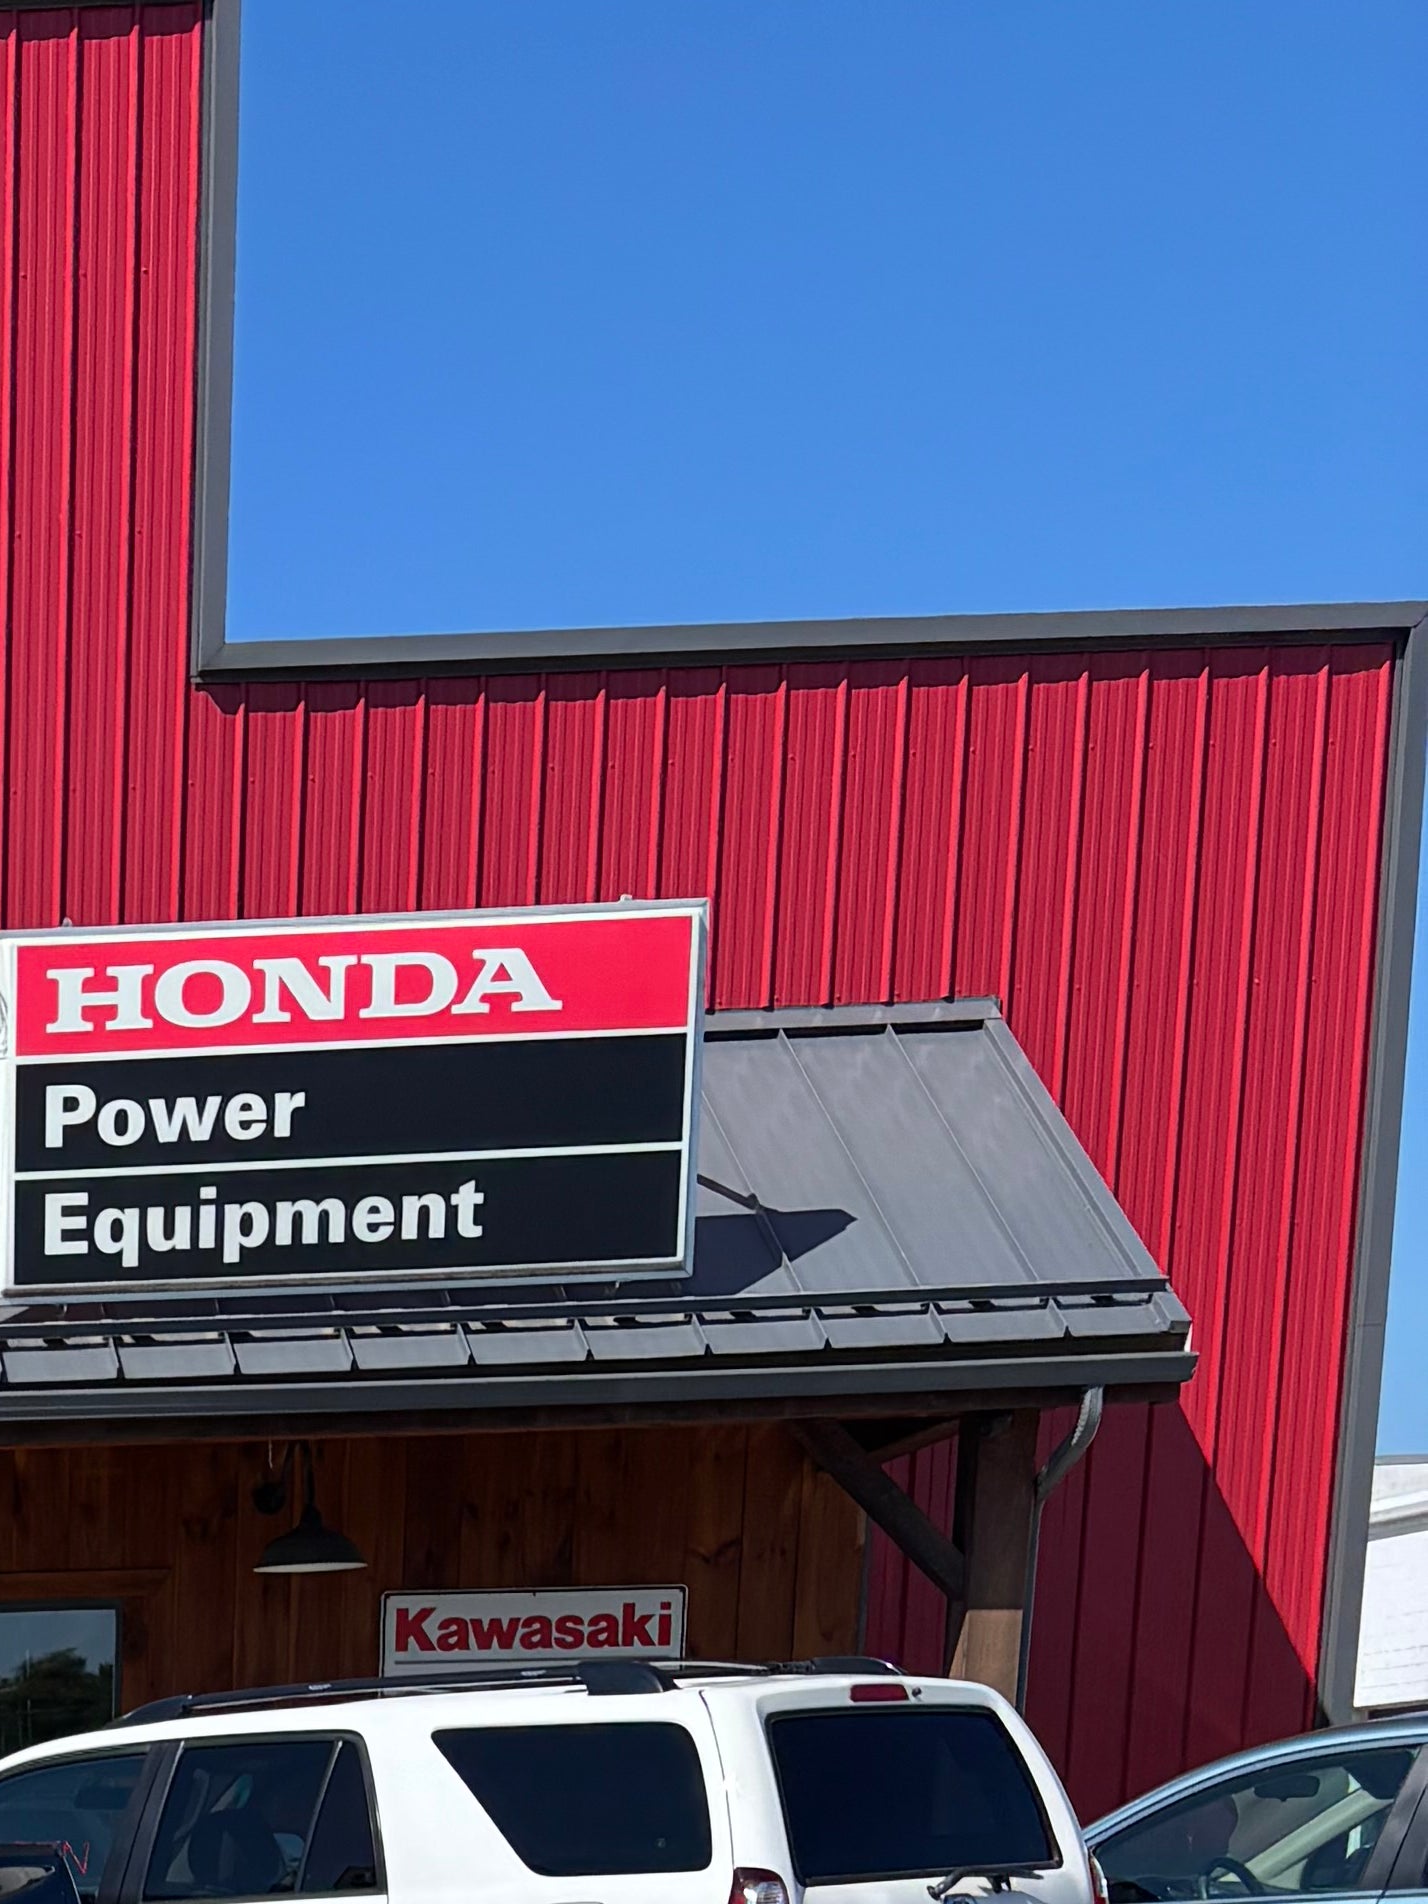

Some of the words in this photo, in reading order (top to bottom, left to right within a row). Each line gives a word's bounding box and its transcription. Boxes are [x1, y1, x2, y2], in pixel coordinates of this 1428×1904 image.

[45, 947, 563, 1034] HONDA
[44, 1084, 306, 1149] Power
[44, 1178, 484, 1268] Equipment
[395, 1601, 672, 1652] Kawasaki
